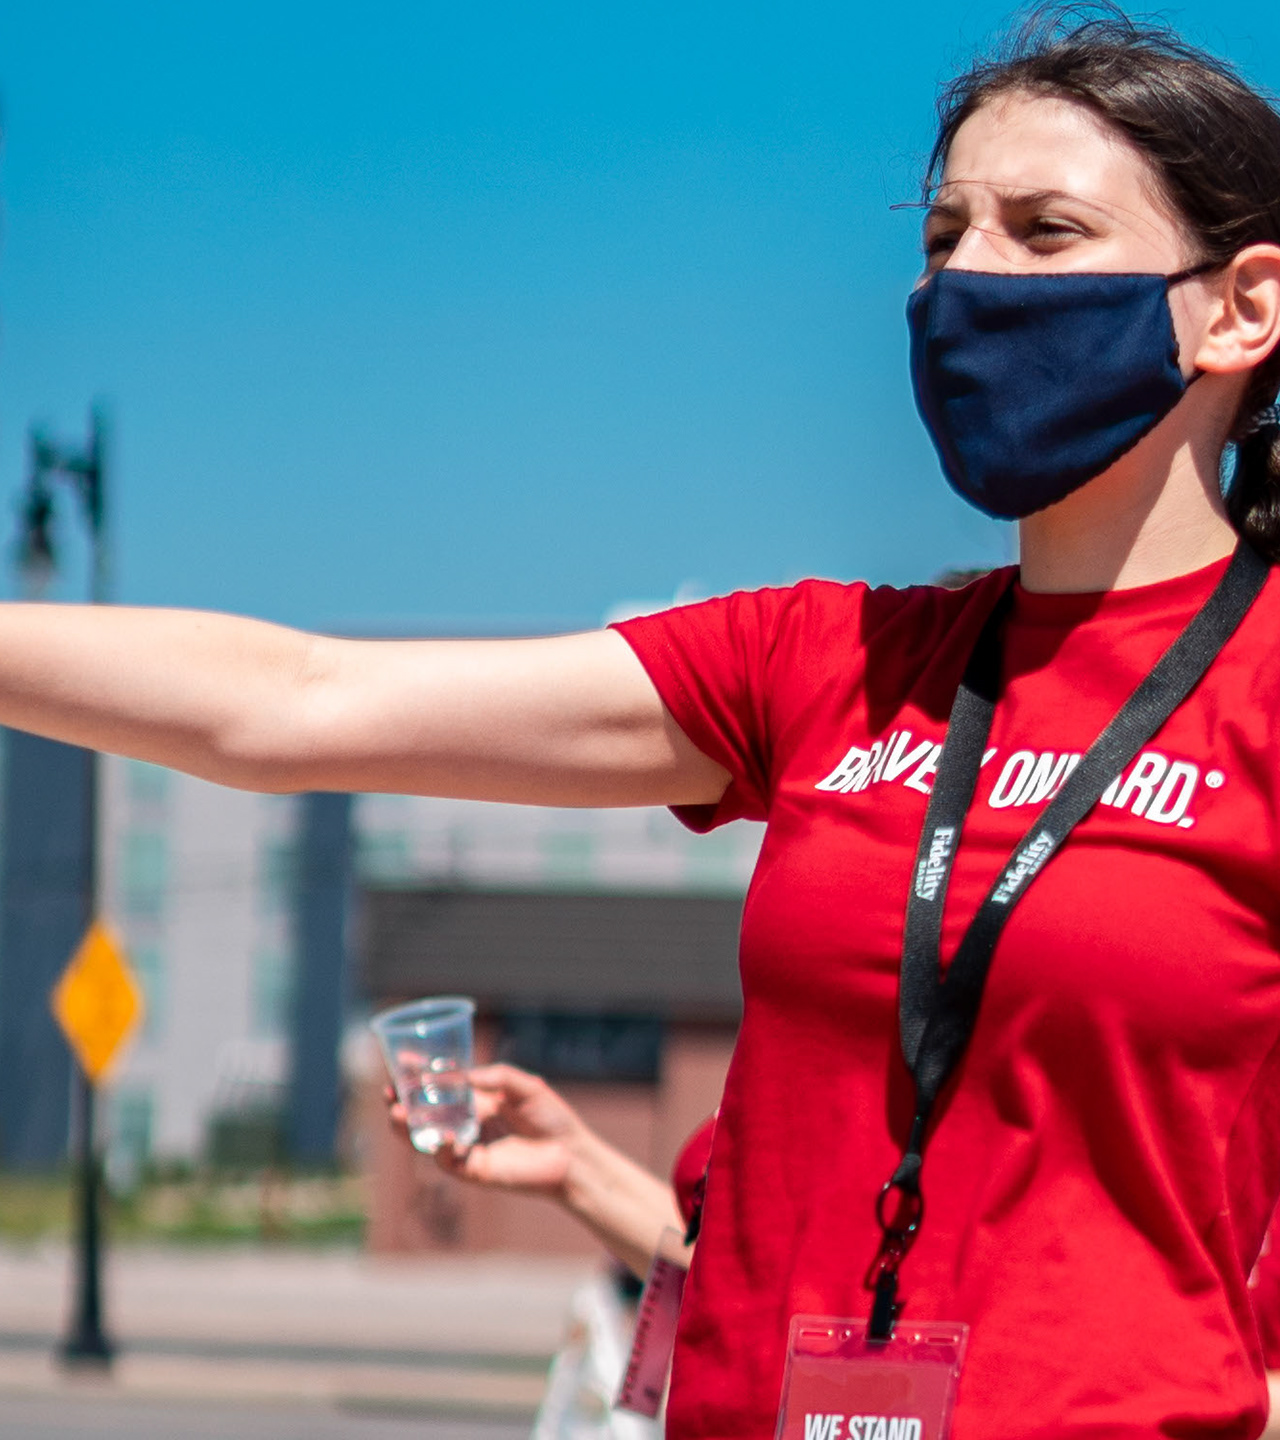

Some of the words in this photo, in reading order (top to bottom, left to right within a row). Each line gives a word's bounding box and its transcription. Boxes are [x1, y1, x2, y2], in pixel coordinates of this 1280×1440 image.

[814, 729, 999, 794] BRAVE
[916, 827, 955, 901] Fidelity
[991, 831, 1055, 904] Fidelity
